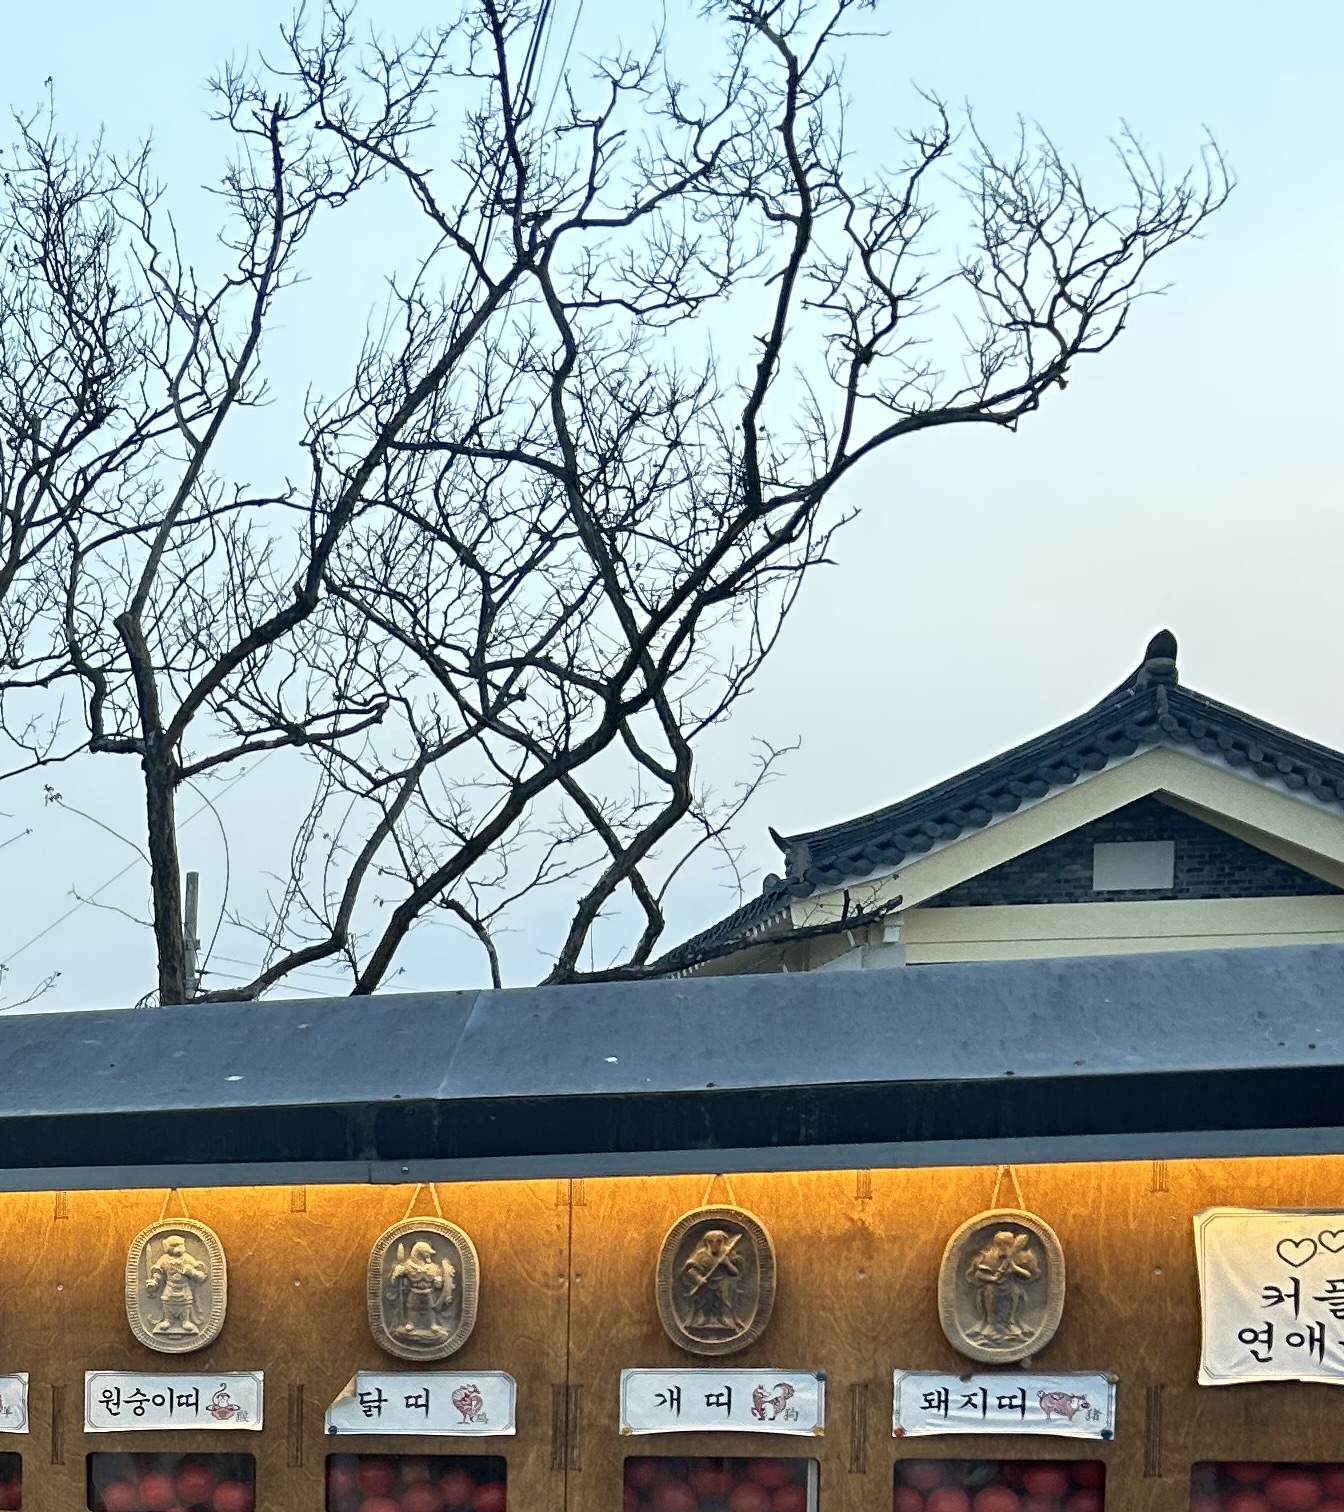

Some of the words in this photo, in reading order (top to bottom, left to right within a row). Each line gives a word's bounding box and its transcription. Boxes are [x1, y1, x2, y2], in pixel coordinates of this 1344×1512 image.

[1237, 1320, 1344, 1366] 연애
[98, 1387, 200, 1418] 원숭이띠
[359, 1388, 388, 1418] 닭
[404, 1387, 429, 1418] 띠
[654, 1385, 680, 1419] 개
[704, 1385, 732, 1420] 띠
[920, 1387, 1026, 1420] 돼지띠
